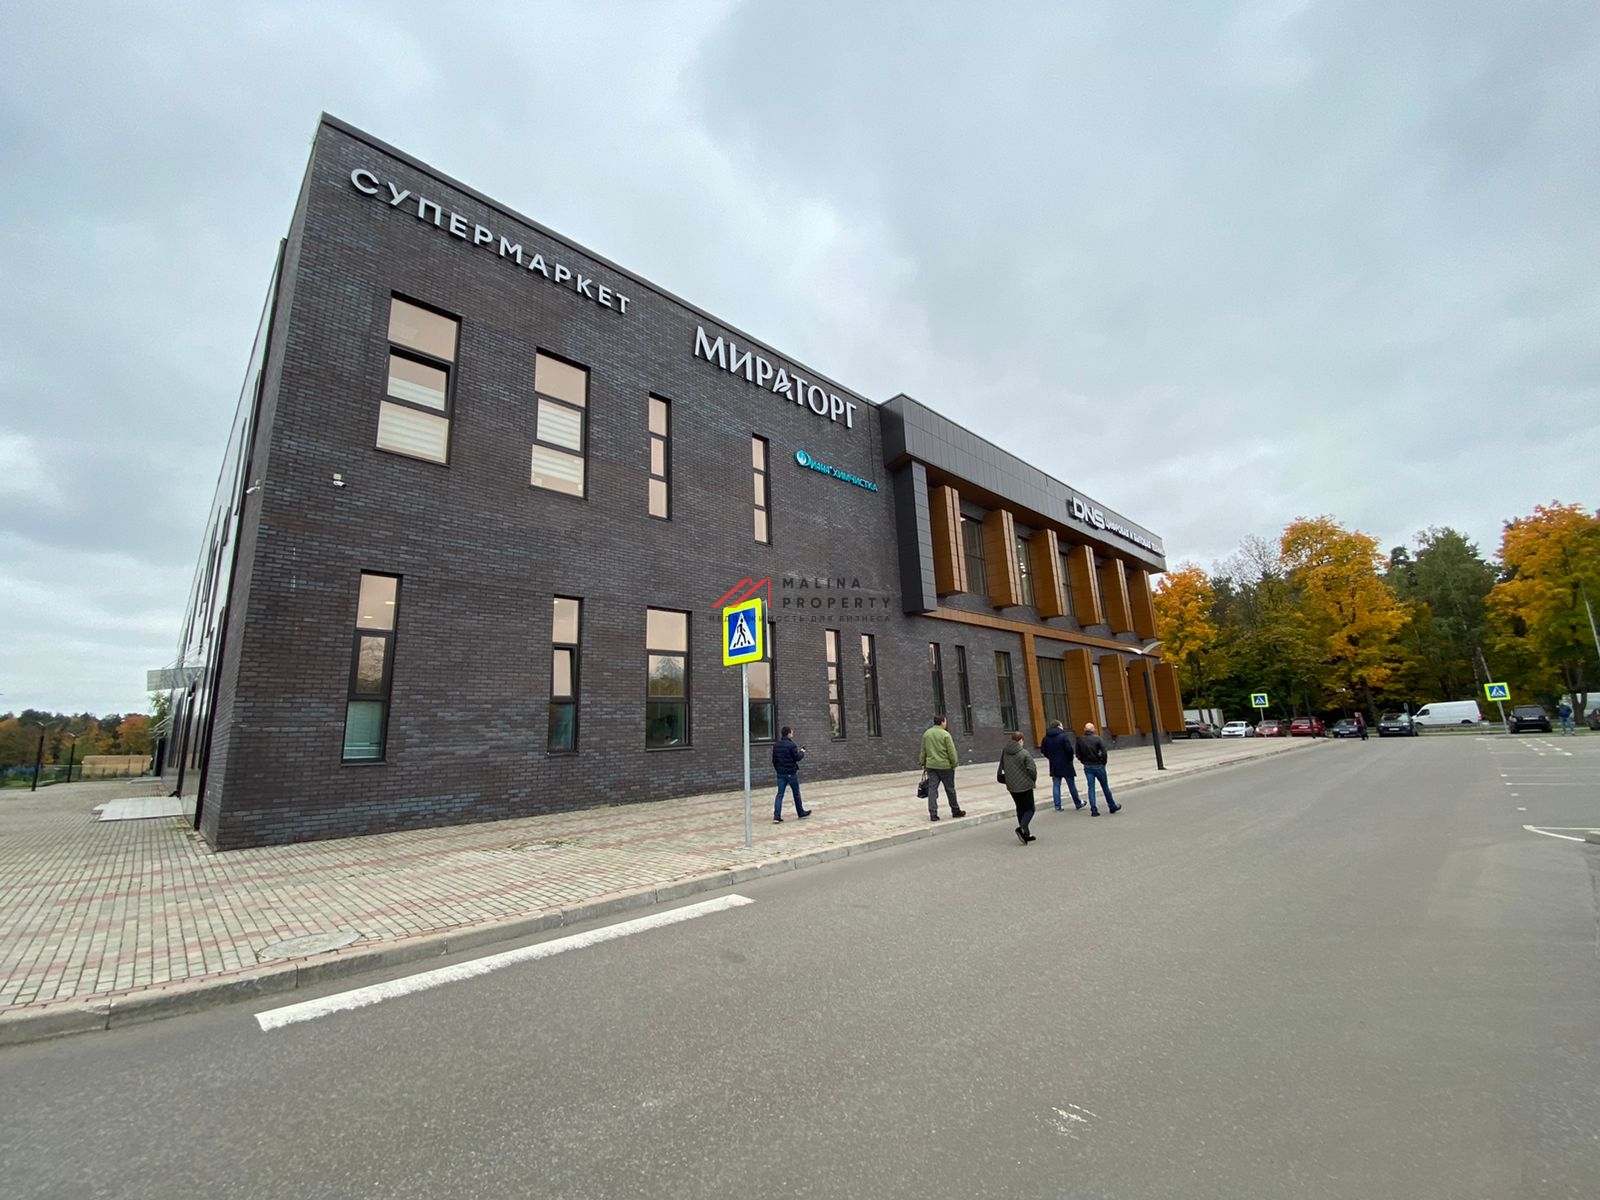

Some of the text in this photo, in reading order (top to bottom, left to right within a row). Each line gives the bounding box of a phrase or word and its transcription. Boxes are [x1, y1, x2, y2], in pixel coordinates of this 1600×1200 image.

[351, 168, 630, 314] СУПЕРМАРКЕТ
[695, 325, 857, 428] МИРАТОРГ
[832, 467, 878, 492] ХИМЧИСТКА
[1072, 496, 1105, 530] DNS
